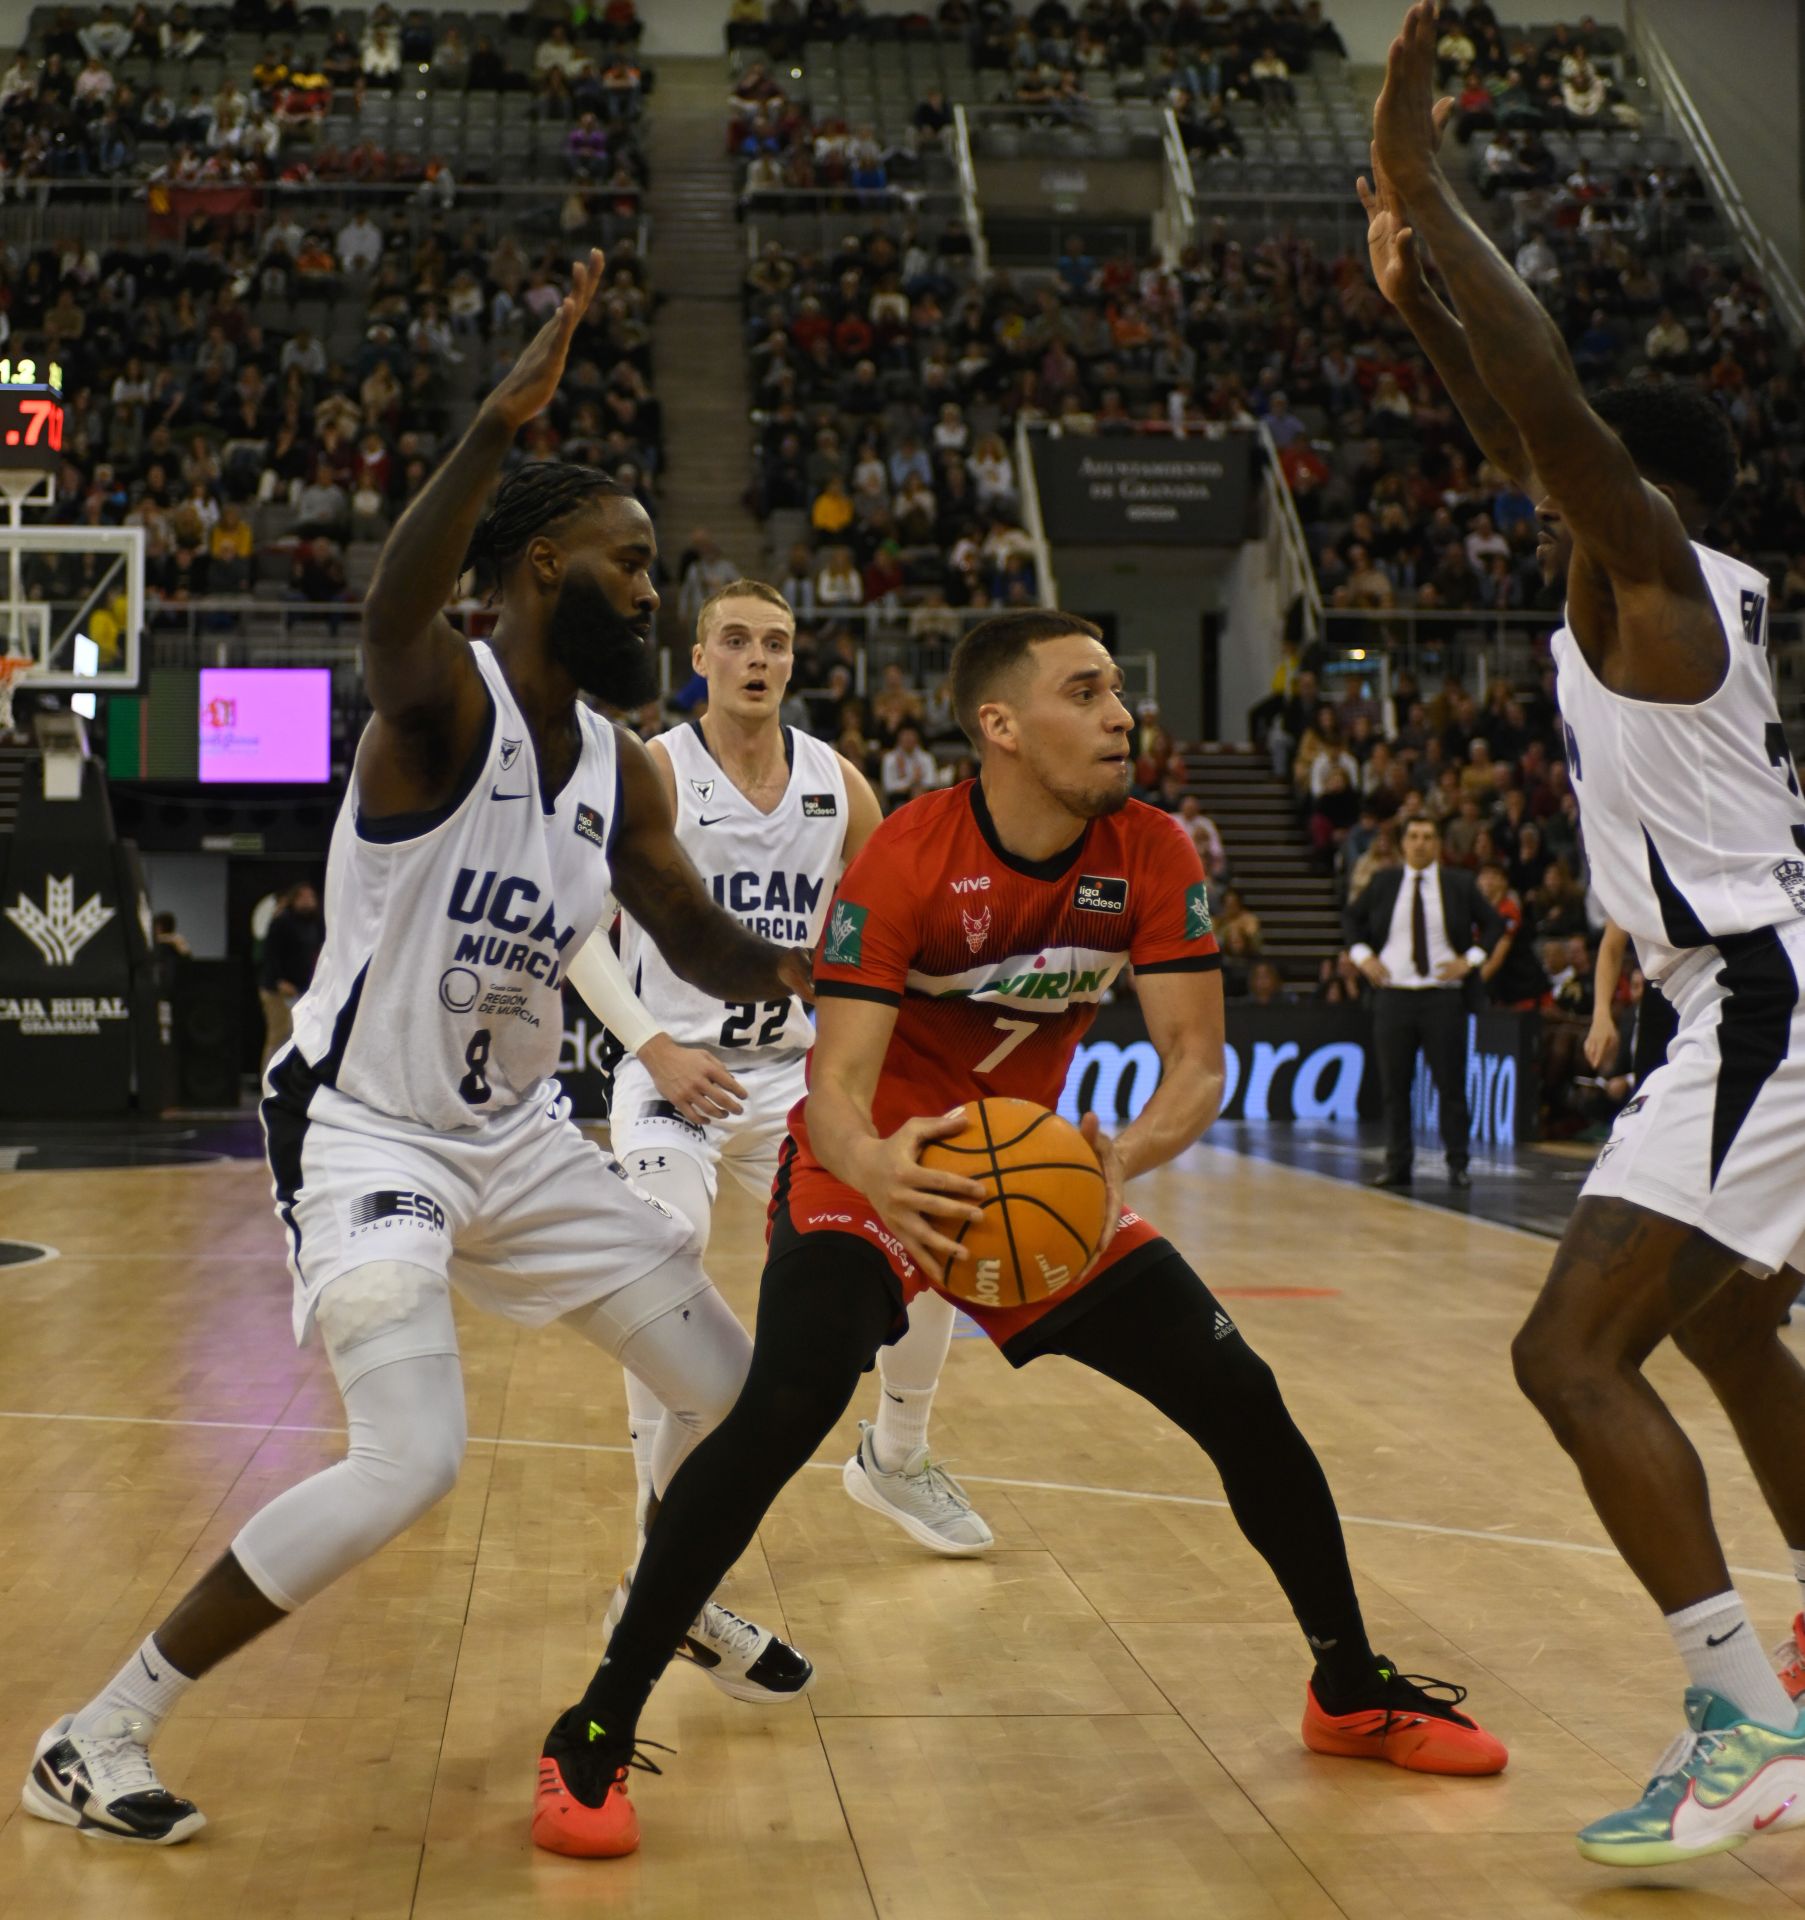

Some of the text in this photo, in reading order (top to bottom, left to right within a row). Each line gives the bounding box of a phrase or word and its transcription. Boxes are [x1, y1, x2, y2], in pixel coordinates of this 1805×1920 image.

[950, 876, 991, 894] vive
[1079, 885, 1100, 898] liga
[1078, 896, 1122, 910] endesa
[51, 997, 129, 1019] RURAL
[478, 1003, 541, 1028] DE MURCIA
[719, 999, 792, 1048] 22
[972, 1017, 1040, 1073] 7
[458, 1029, 492, 1105] 8
[808, 1213, 852, 1225] vive
